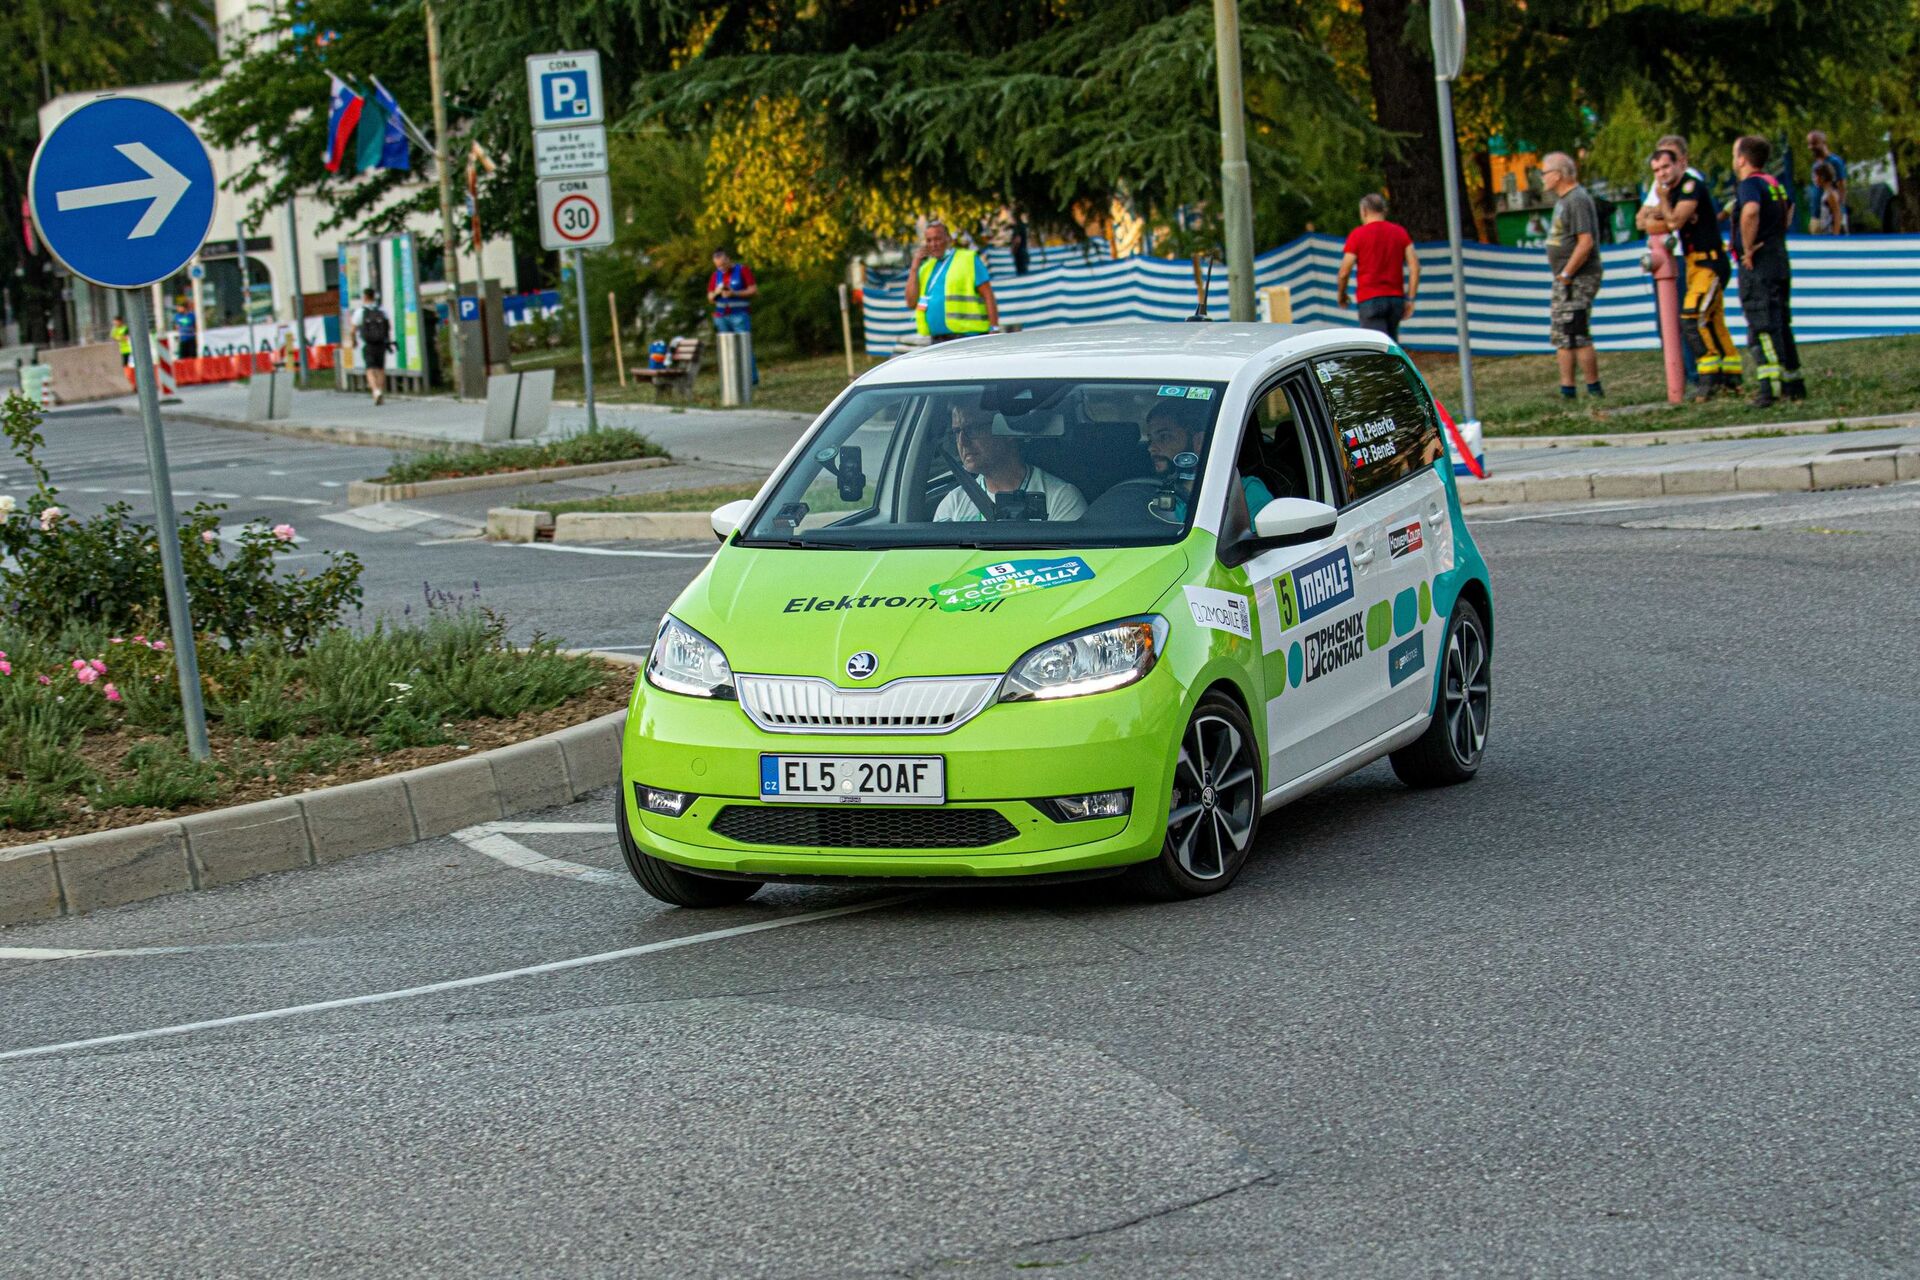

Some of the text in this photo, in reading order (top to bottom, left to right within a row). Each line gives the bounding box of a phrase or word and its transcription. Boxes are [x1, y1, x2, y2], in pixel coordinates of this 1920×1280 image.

[549, 60, 577, 70] CONA
[551, 77, 577, 112] P
[559, 181, 588, 192] CONA
[564, 207, 590, 230] 30
[461, 300, 475, 317] P
[981, 569, 1035, 586] MAHLE
[995, 565, 1007, 574] 5
[1279, 558, 1349, 626] 5 MAHLE
[783, 594, 1006, 613] Elektromil
[1321, 635, 1364, 675] CONTACT
[764, 781, 777, 791] CZ
[784, 762, 928, 793] EL5 20AF
